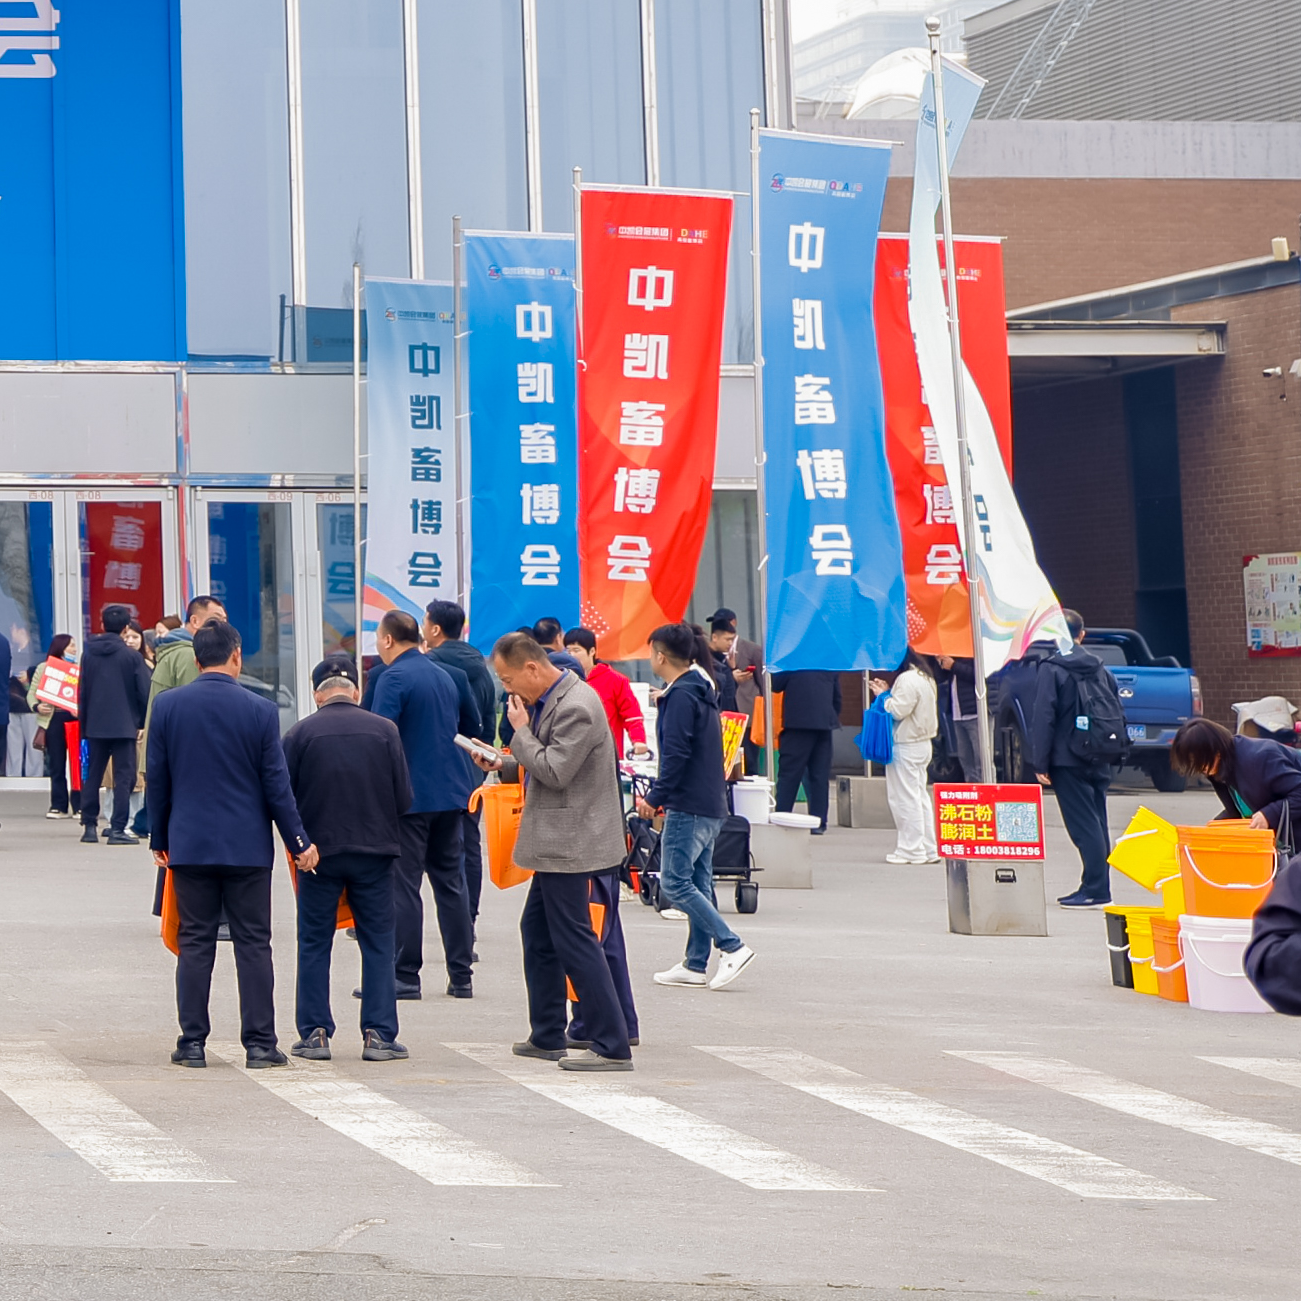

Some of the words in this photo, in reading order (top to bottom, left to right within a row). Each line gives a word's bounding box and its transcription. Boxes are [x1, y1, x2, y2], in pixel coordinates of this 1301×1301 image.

[407, 341, 443, 590] 中凯畜博会
[515, 301, 562, 587] 中凯畜博会
[606, 265, 676, 584] 中凯畜博会
[787, 220, 854, 578] 中凯畜博会
[939, 804, 993, 821] 沸石粉
[940, 823, 994, 840] 膨润土
